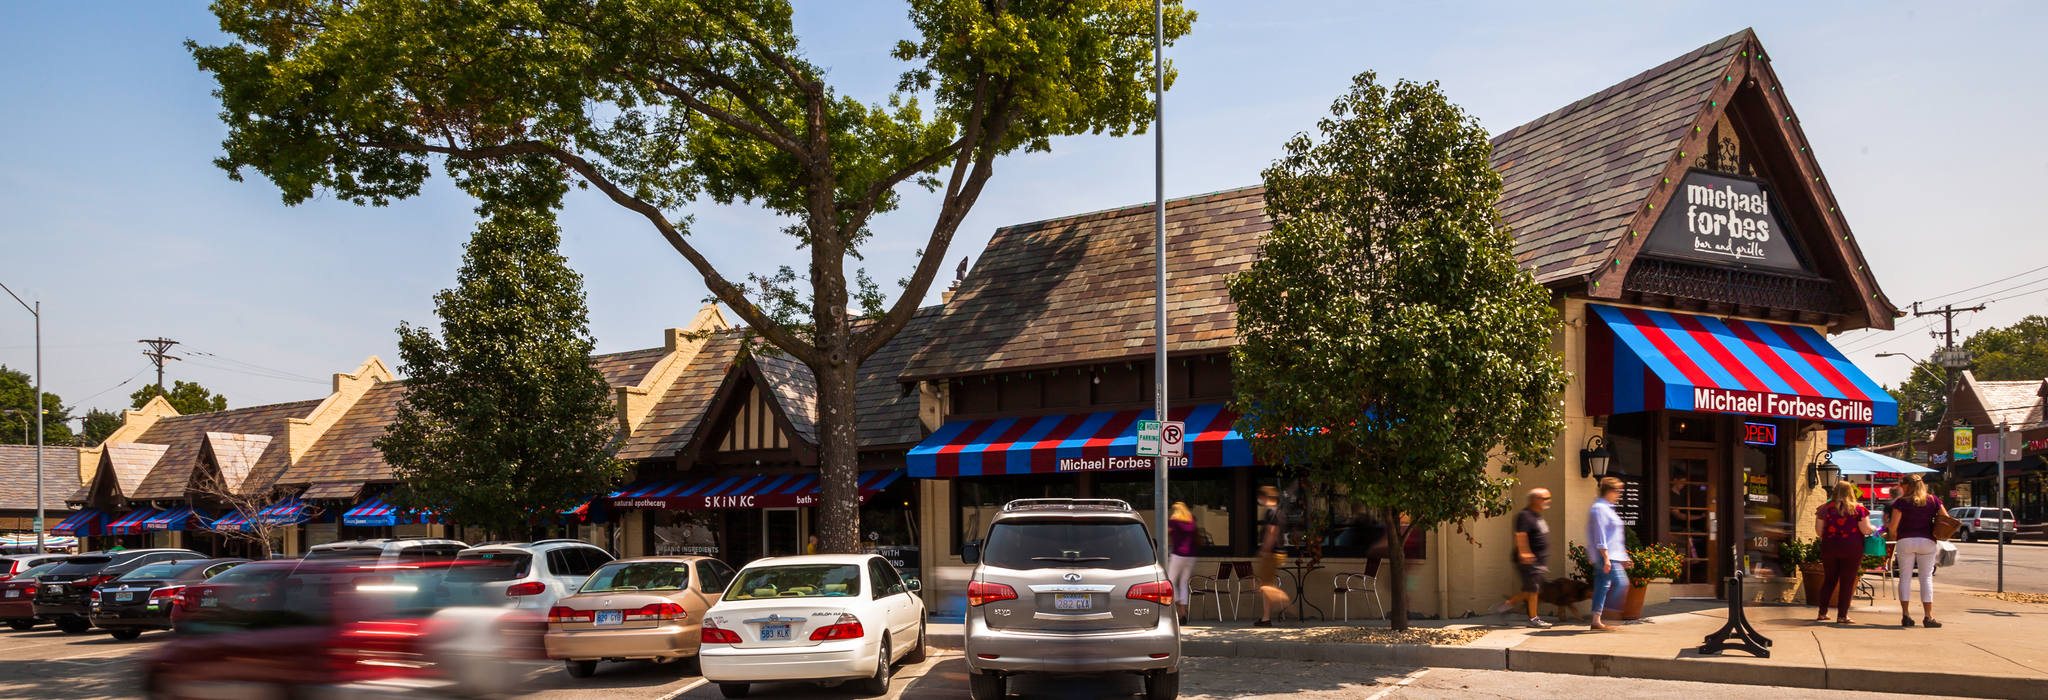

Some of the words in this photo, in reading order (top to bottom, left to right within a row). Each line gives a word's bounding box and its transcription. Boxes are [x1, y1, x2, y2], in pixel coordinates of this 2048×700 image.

[1687, 184, 1768, 215] michael
[1687, 205, 1770, 242] forbes
[1694, 236, 1712, 249] bar
[1715, 238, 1734, 255] and
[1736, 241, 1765, 259] grille
[1694, 388, 1762, 413] Michael
[1767, 394, 1825, 418] Forbes
[1829, 400, 1872, 422] Grille
[1060, 457, 1105, 471] Michael
[1108, 457, 1151, 470] Forbes
[614, 499, 633, 507] natural
[634, 498, 666, 508] apothecary
[739, 495, 755, 507] KC
[796, 495, 812, 504] bath
[1753, 536, 1768, 547] 128
[881, 549, 900, 557] WITH
